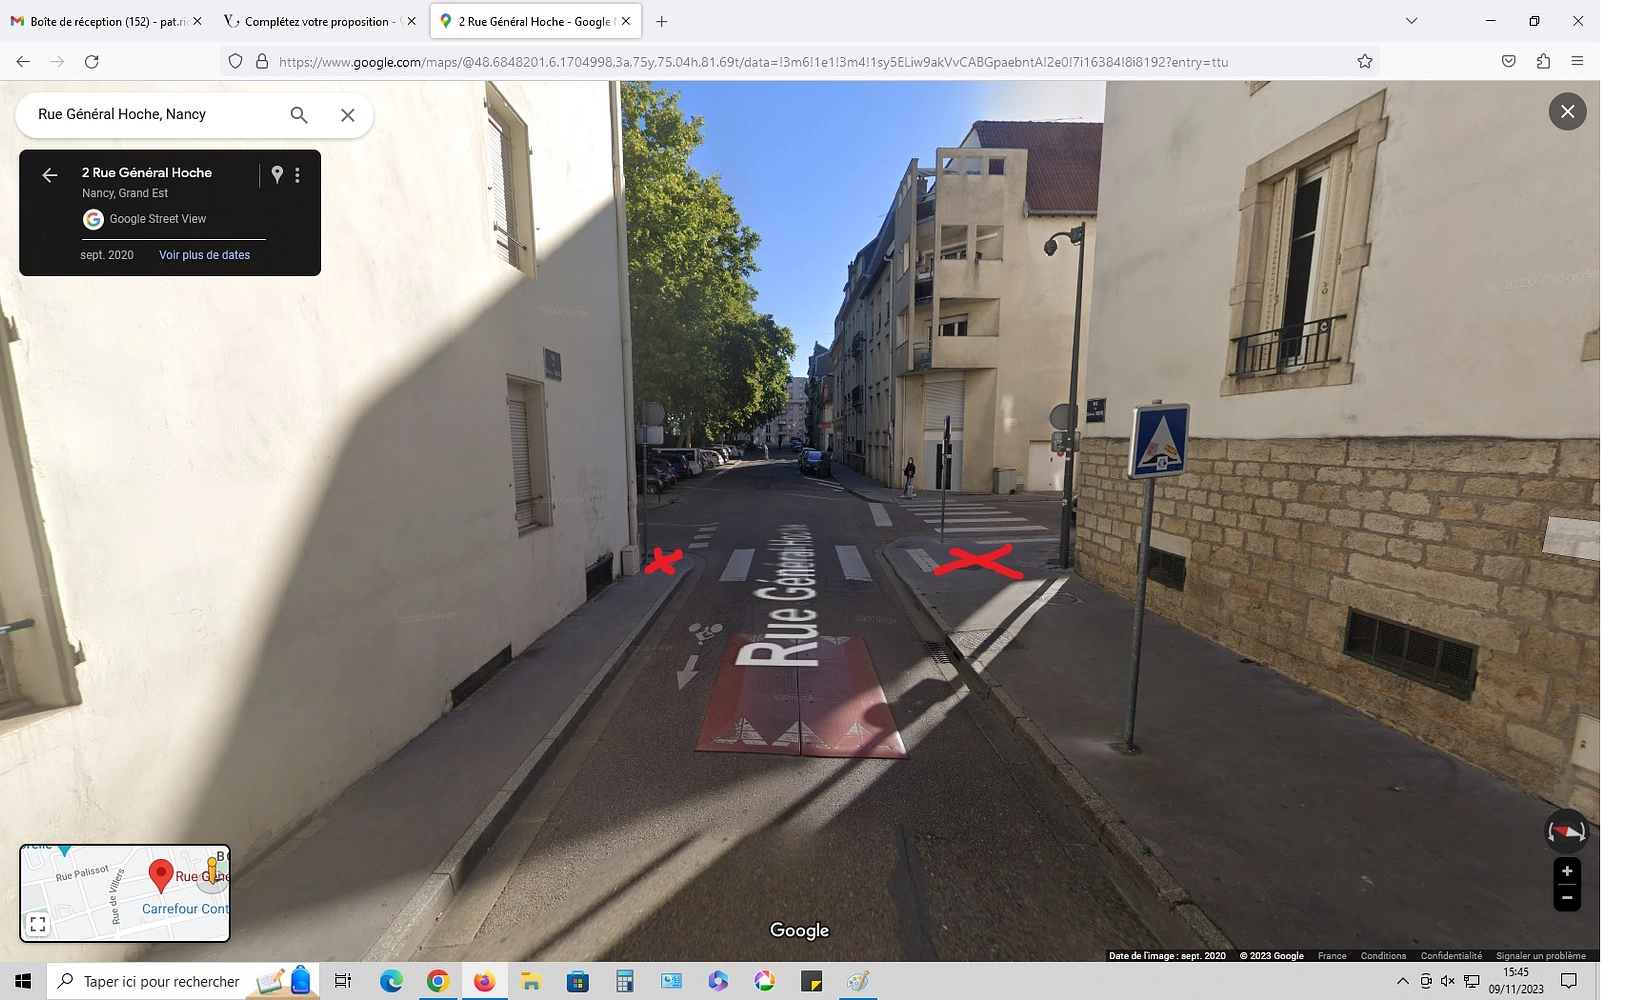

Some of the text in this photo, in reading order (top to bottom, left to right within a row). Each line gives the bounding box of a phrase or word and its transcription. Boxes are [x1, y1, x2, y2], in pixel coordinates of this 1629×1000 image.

[30, 15, 58, 27] Boîte
[59, 16, 73, 27] de
[74, 16, 123, 30] réception
[125, 16, 150, 29] (152)
[244, 16, 300, 30] Complétez
[301, 17, 329, 27] votre
[330, 16, 389, 30] proposition
[458, 16, 466, 27] 2
[467, 16, 488, 27] Rue
[489, 16, 528, 27] Général
[530, 16, 565, 27] Hoche
[574, 16, 612, 30] Google
[38, 106, 207, 123] Rue Général Hoche, Nancy
[81, 166, 213, 178] 2 Rue Général Hoche
[82, 187, 169, 200] Nancy, Grand Est
[109, 213, 147, 226] Google
[148, 213, 179, 224] Street
[181, 213, 207, 224] View
[80, 249, 134, 262] sept. 2020
[158, 249, 251, 262] Voir plus de dates
[56, 864, 109, 882] Rue Palissot
[175, 870, 198, 882] Rue
[108, 868, 125, 925] Rue de Villers
[142, 902, 198, 914] Carrefour
[770, 922, 829, 942] Google
[1109, 950, 1130, 960] Date
[1130, 950, 1142, 960] de
[1143, 950, 1175, 962] l'image
[1180, 951, 1203, 962] sept.
[1204, 951, 1227, 960] 2020
[1249, 950, 1272, 960] 2023
[1273, 950, 1305, 962] Google
[1318, 950, 1348, 960] France
[1360, 950, 1407, 960] Conditions
[1420, 950, 1483, 960] Confidentialité
[1495, 950, 1532, 962] Signaler
[1545, 950, 1587, 962] problème
[1503, 966, 1529, 977] 15:45
[83, 975, 241, 991] Taper ici pour rechercher
[1488, 983, 1545, 995] 09/11/2023
